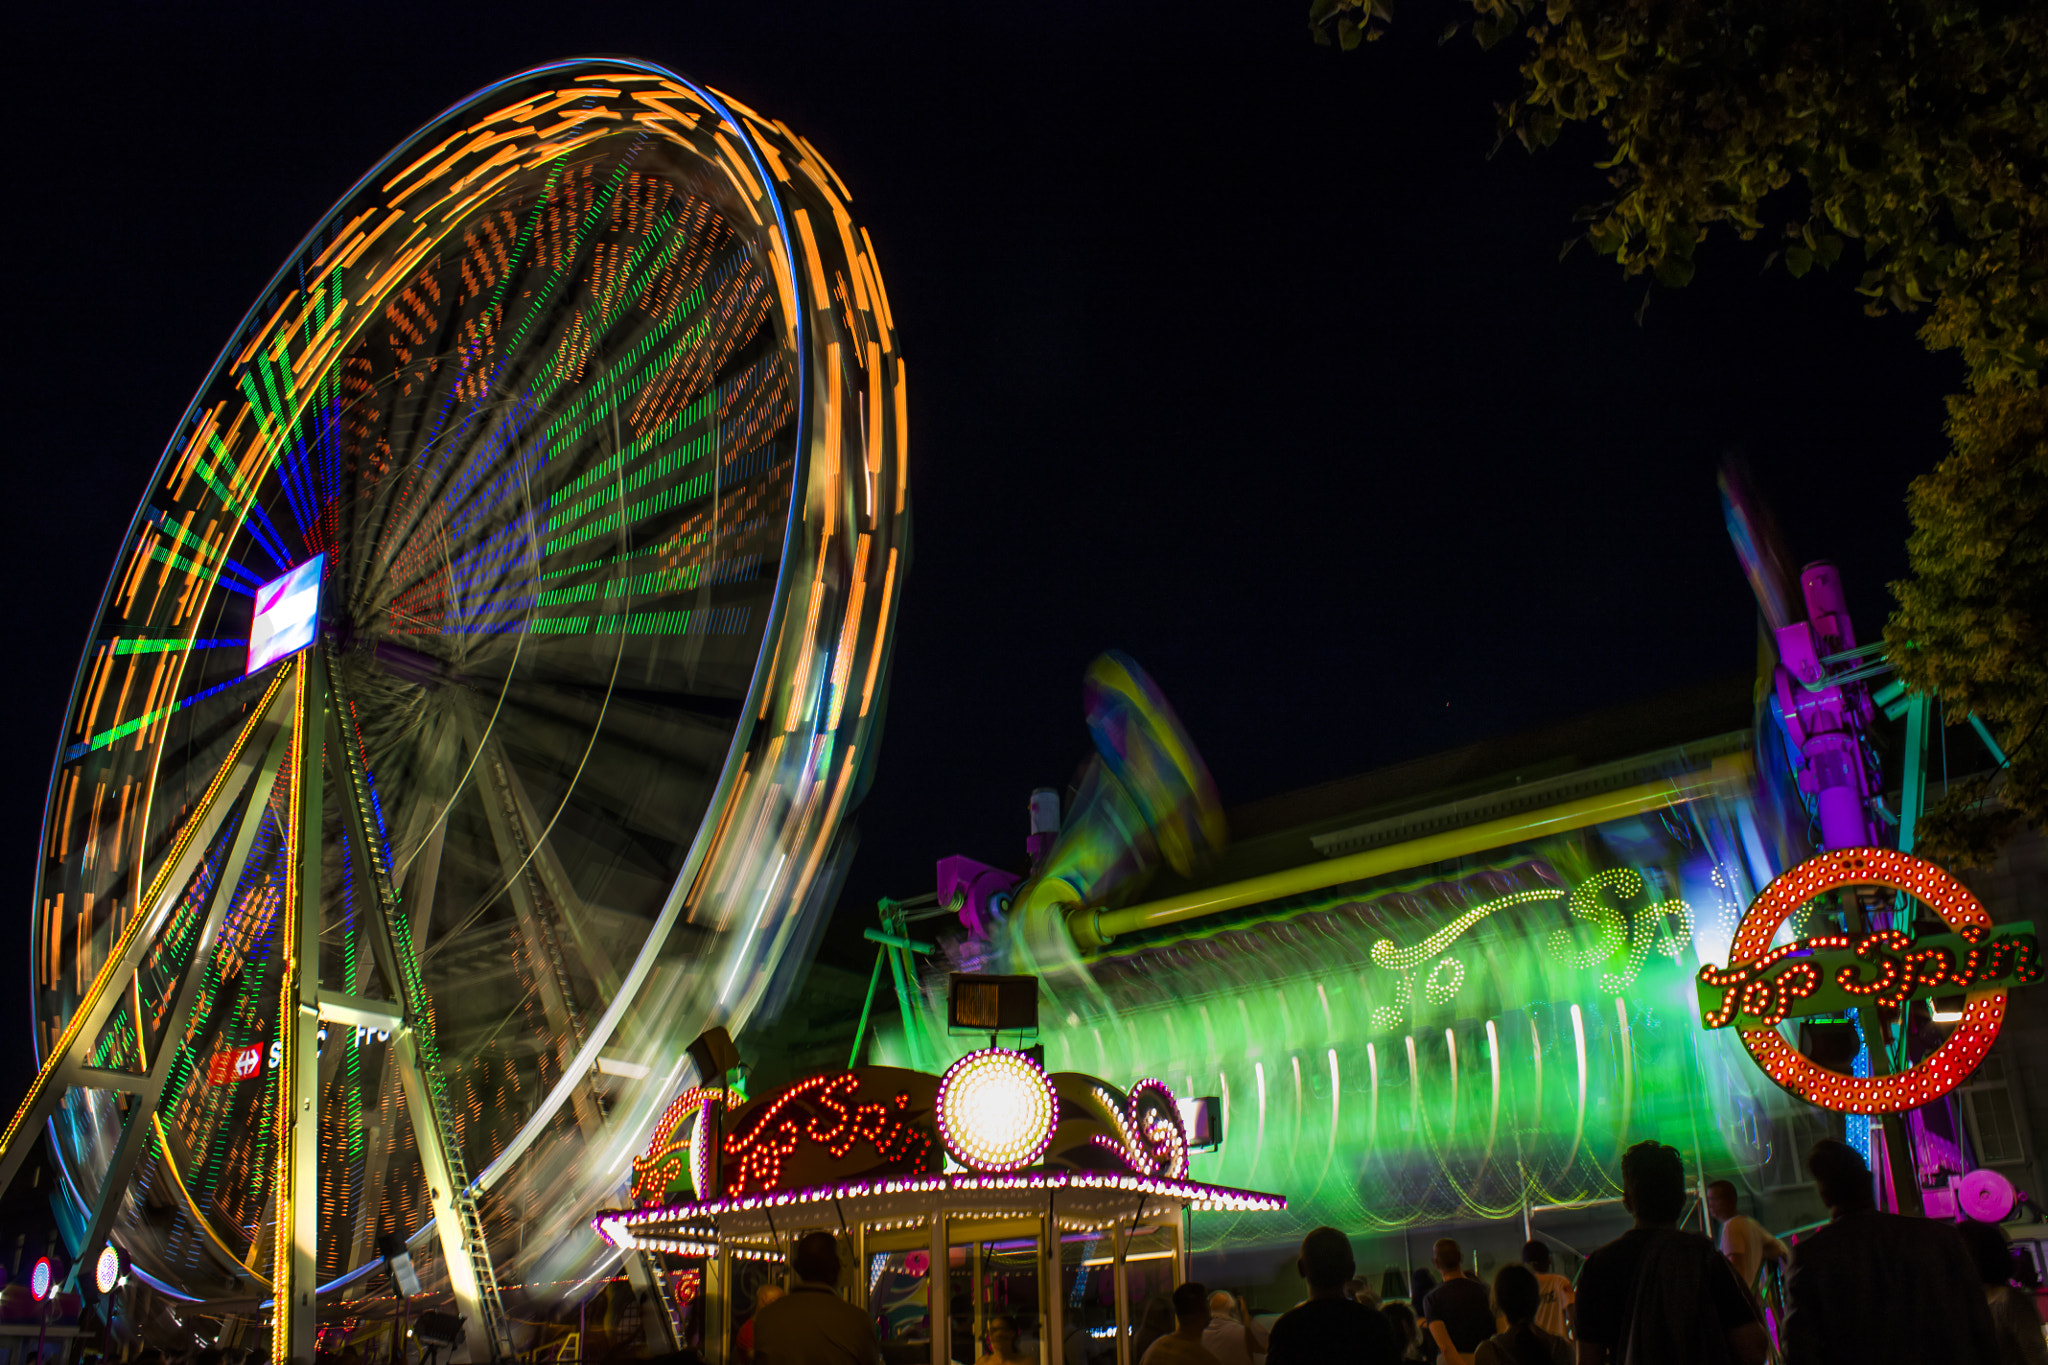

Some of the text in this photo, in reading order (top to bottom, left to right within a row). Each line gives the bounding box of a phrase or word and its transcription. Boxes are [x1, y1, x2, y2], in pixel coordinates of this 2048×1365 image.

[1370, 889, 1567, 1031] To
[1700, 926, 2043, 1028] Top Spin
